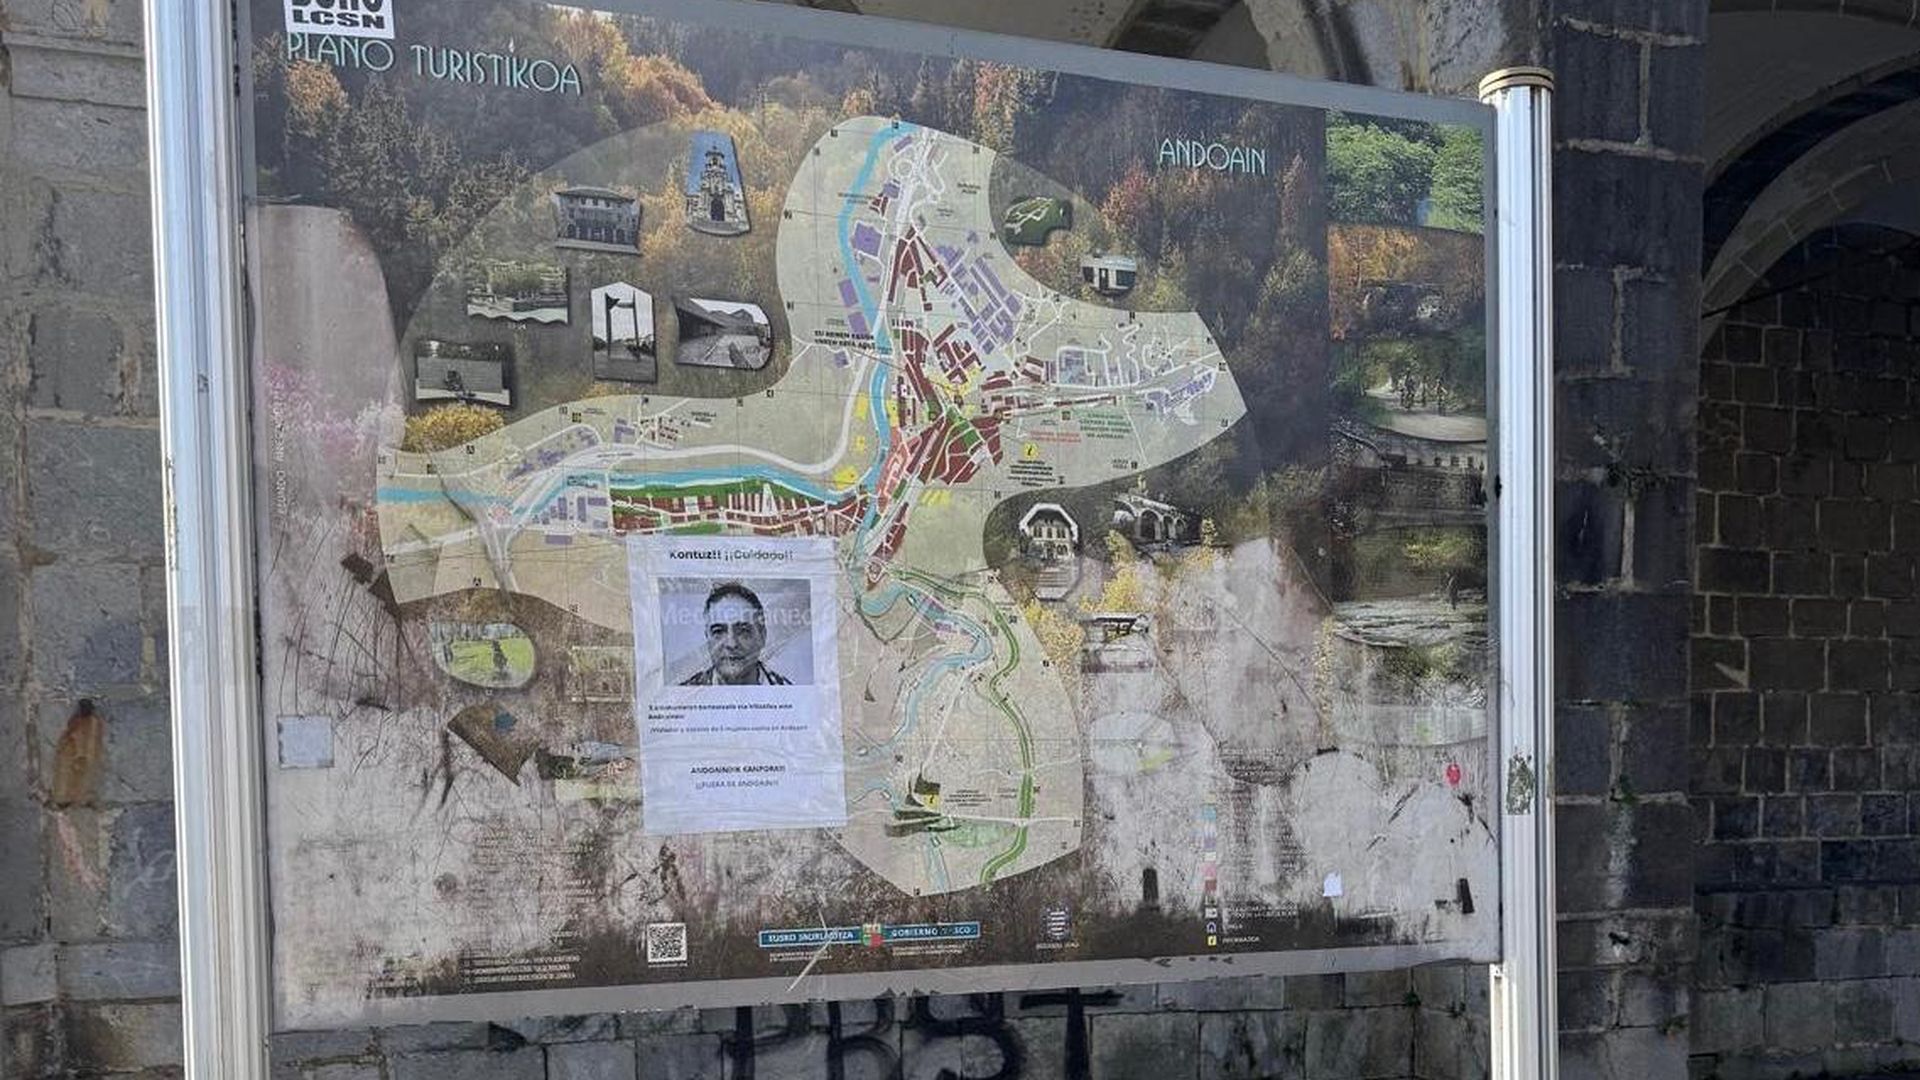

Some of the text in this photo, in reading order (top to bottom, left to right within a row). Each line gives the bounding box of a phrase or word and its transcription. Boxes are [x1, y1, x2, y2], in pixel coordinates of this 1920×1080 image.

[292, 9, 385, 29] LCSN
[287, 32, 583, 96] PLANO TURISTIKOA
[1160, 138, 1265, 175] ANDOAIN
